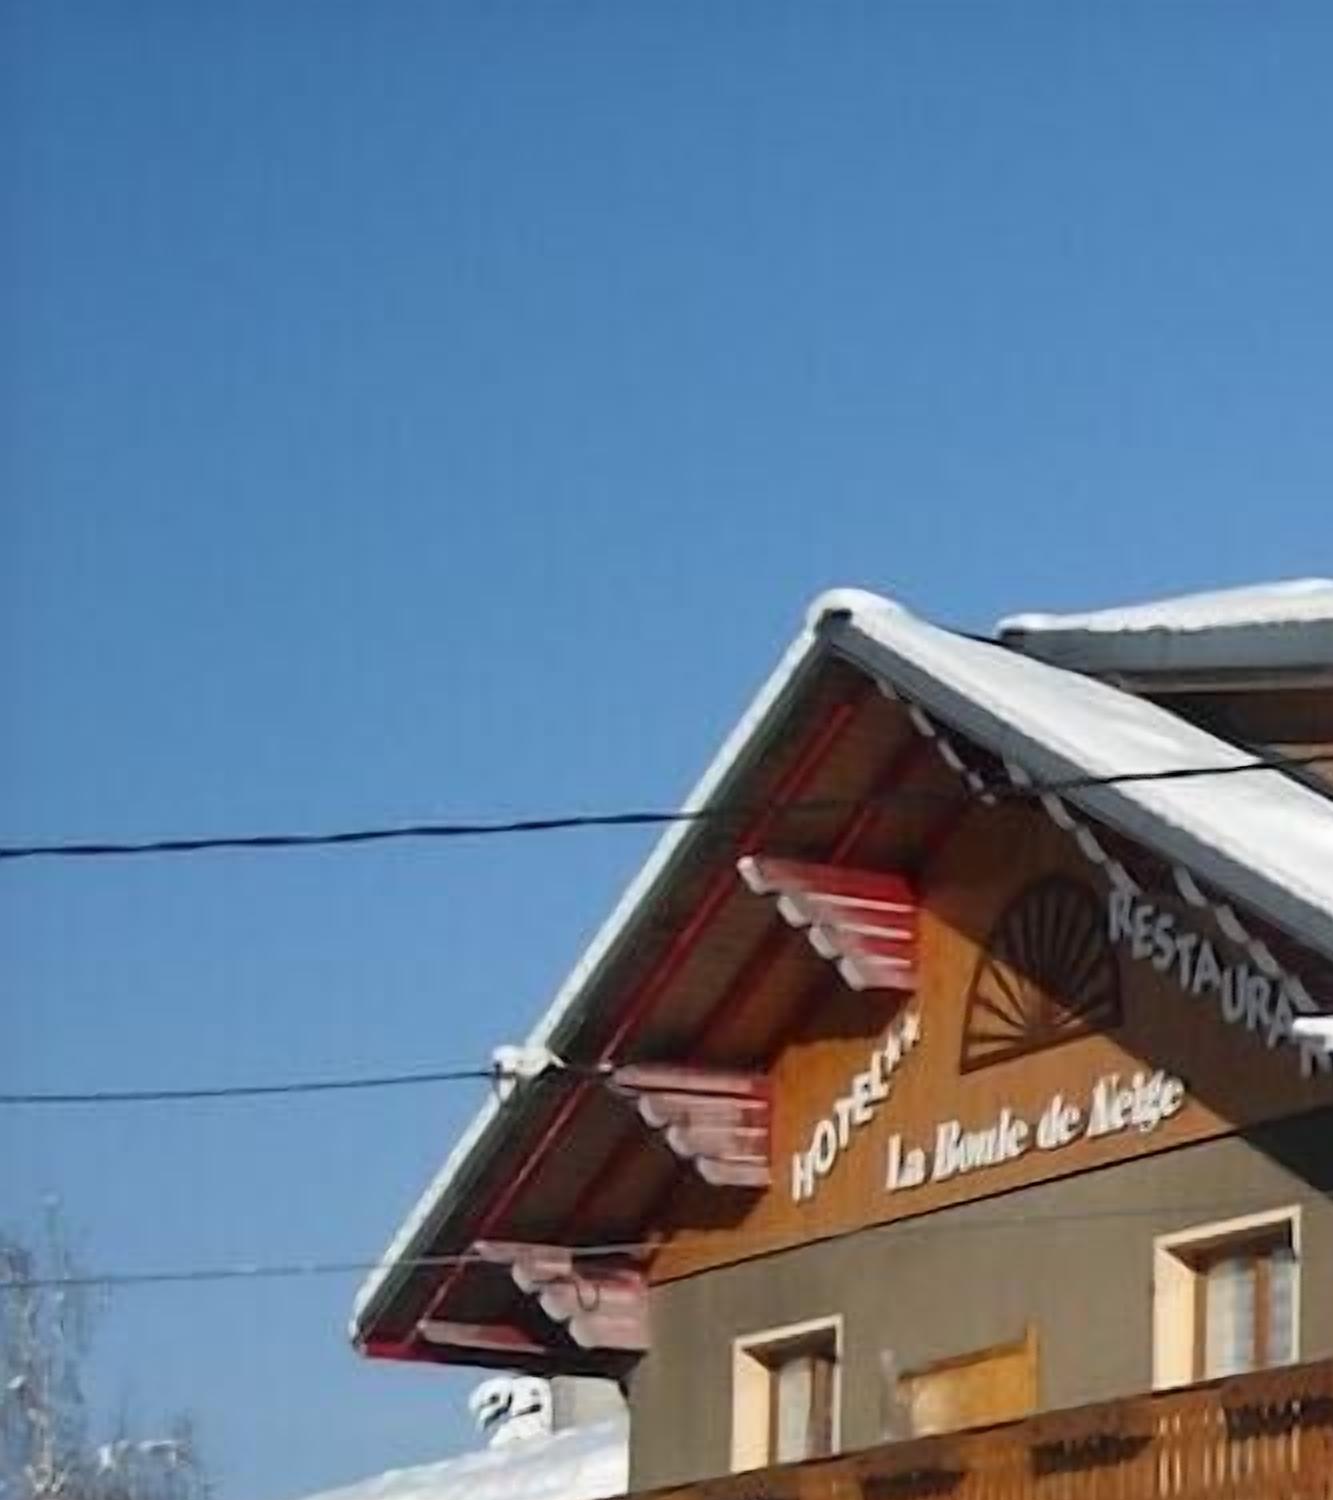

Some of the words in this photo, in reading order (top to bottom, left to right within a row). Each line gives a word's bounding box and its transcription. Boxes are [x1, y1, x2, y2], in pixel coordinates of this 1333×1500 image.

[791, 1050, 890, 1202] HOTEL
[885, 1132, 926, 1191] La
[931, 1118, 1029, 1182] Boule
[1036, 1094, 1081, 1150] de
[1086, 1069, 1185, 1139] Neige
